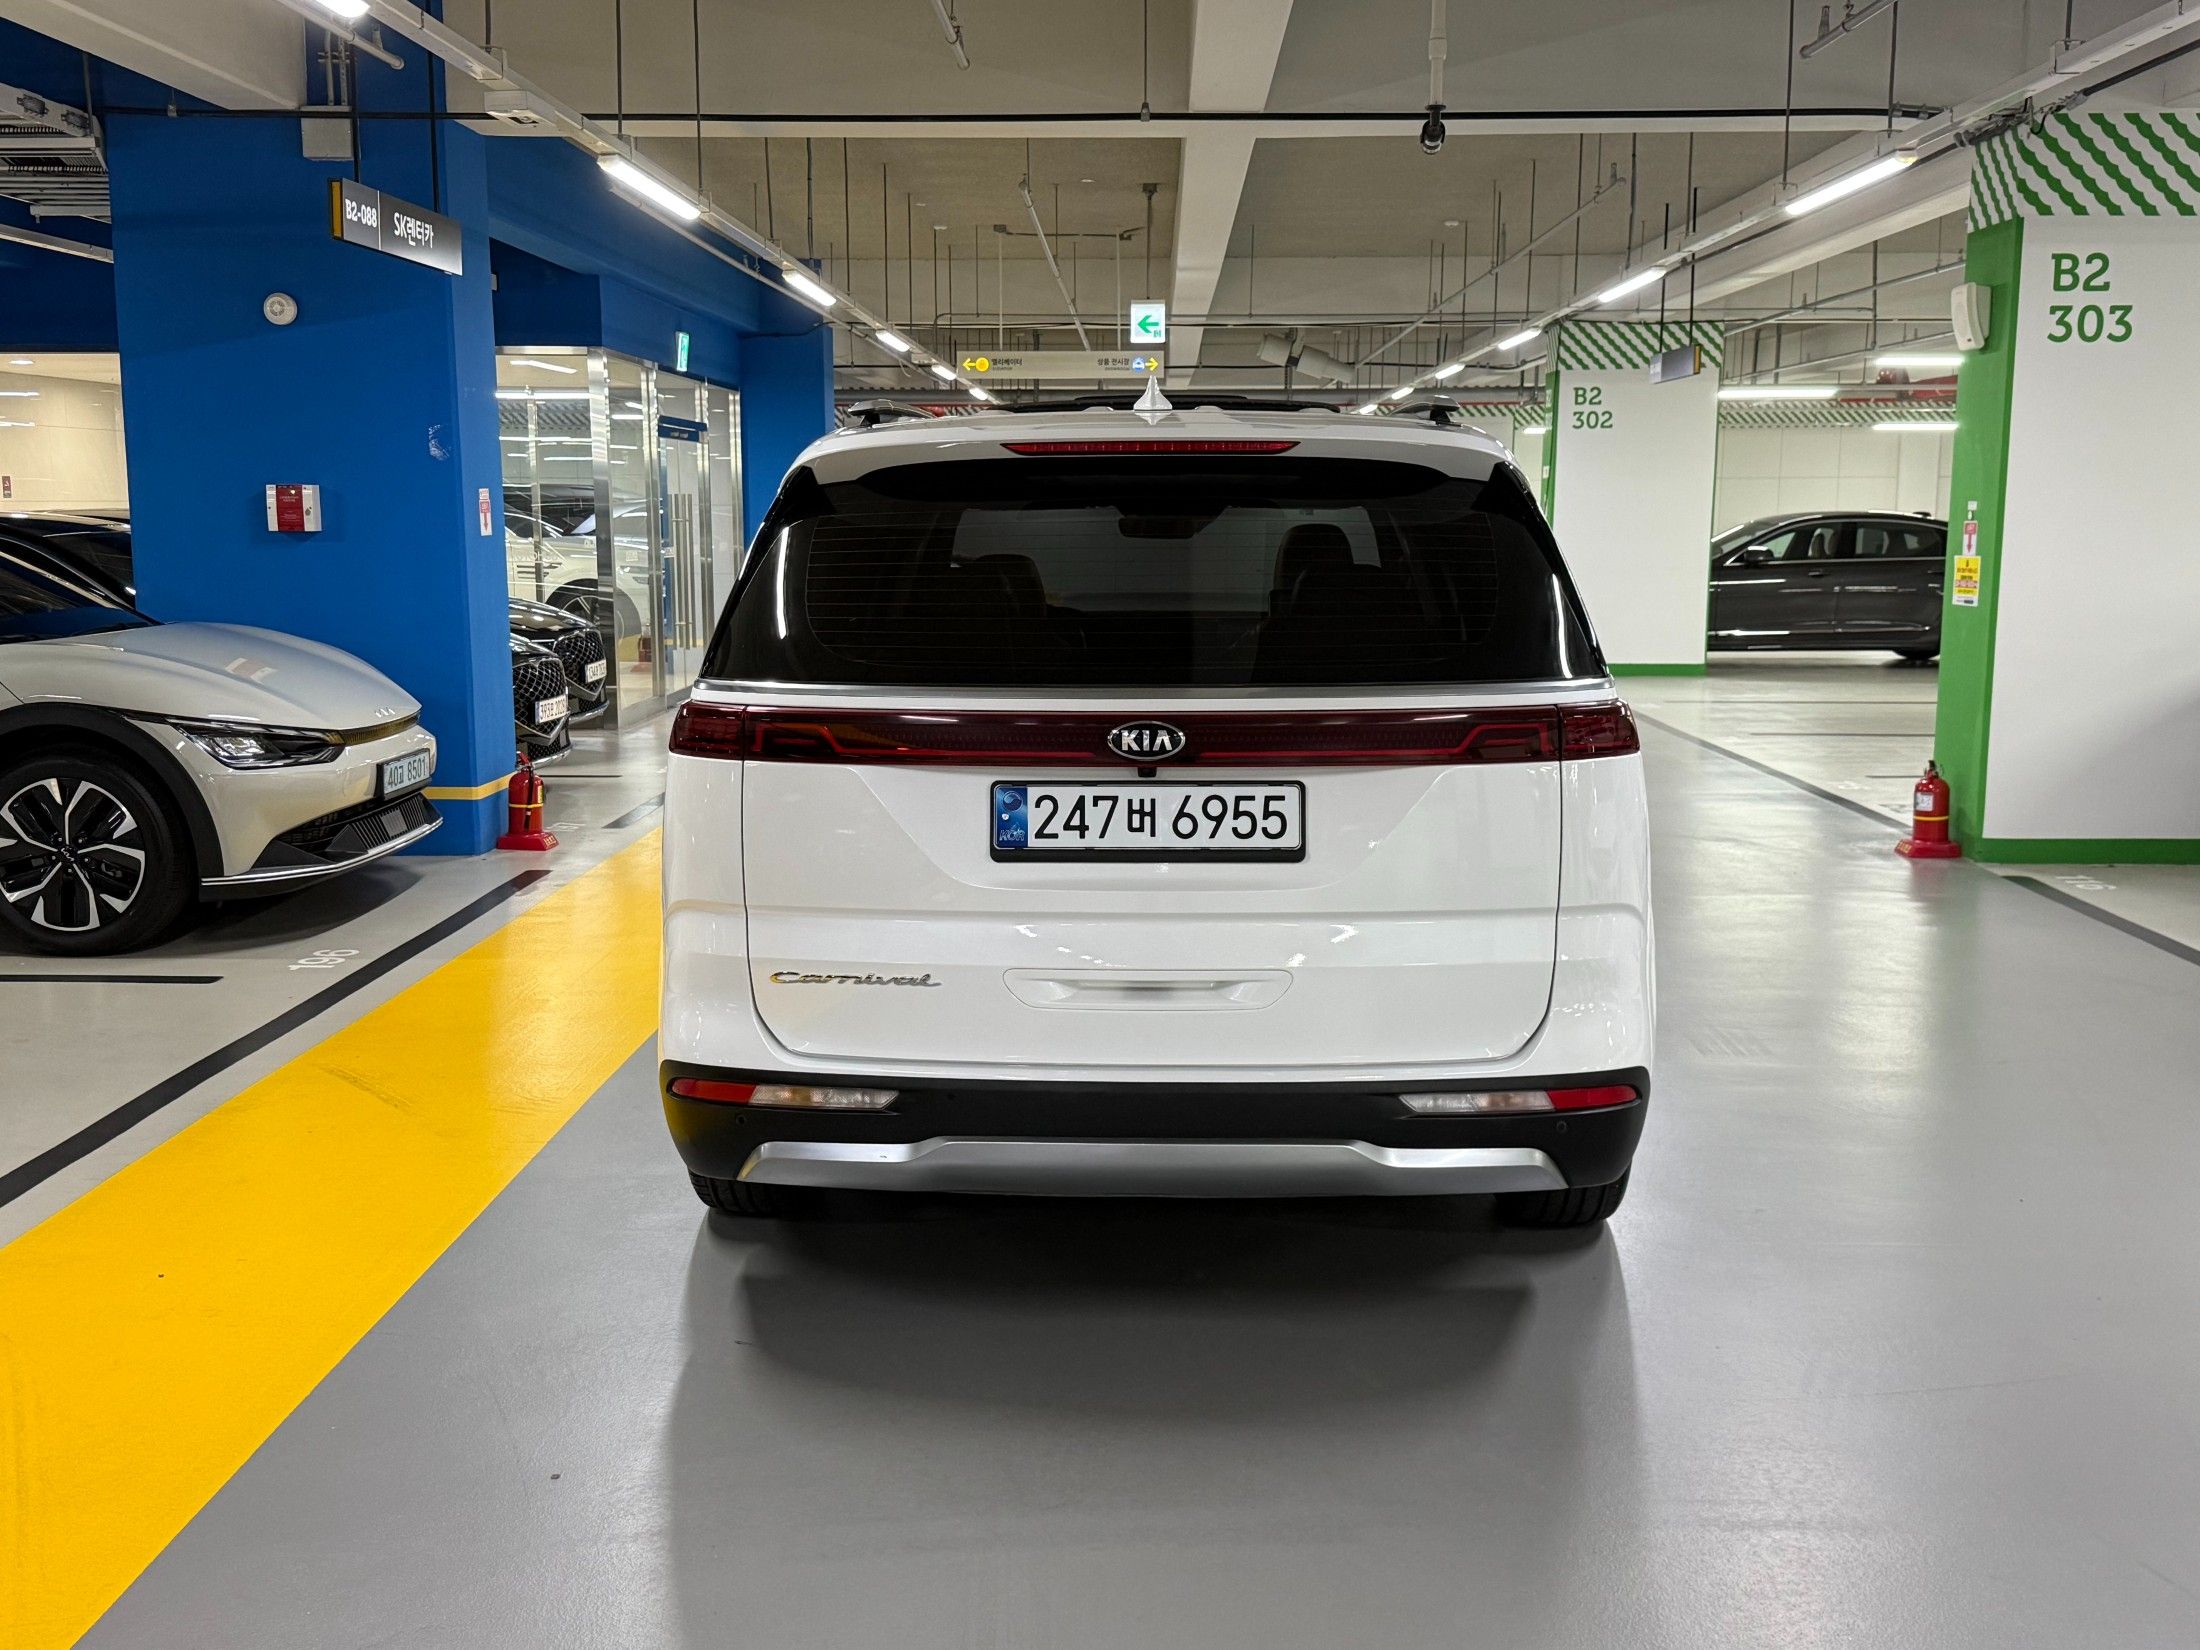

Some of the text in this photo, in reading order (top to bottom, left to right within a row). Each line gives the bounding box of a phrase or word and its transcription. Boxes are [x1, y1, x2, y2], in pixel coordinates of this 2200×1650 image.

[345, 199, 377, 228] B2-088
[393, 212, 434, 248] SK렌터카
[2051, 252, 2110, 292] B2
[2047, 304, 2133, 343] 303
[1573, 387, 1602, 405] B2
[1572, 411, 1613, 429] 302
[1121, 729, 1173, 751] KIA
[407, 755, 426, 781] 8501
[1034, 794, 1288, 840] 247버 6955
[287, 949, 360, 971] 196
[769, 971, 942, 988] Carnival
